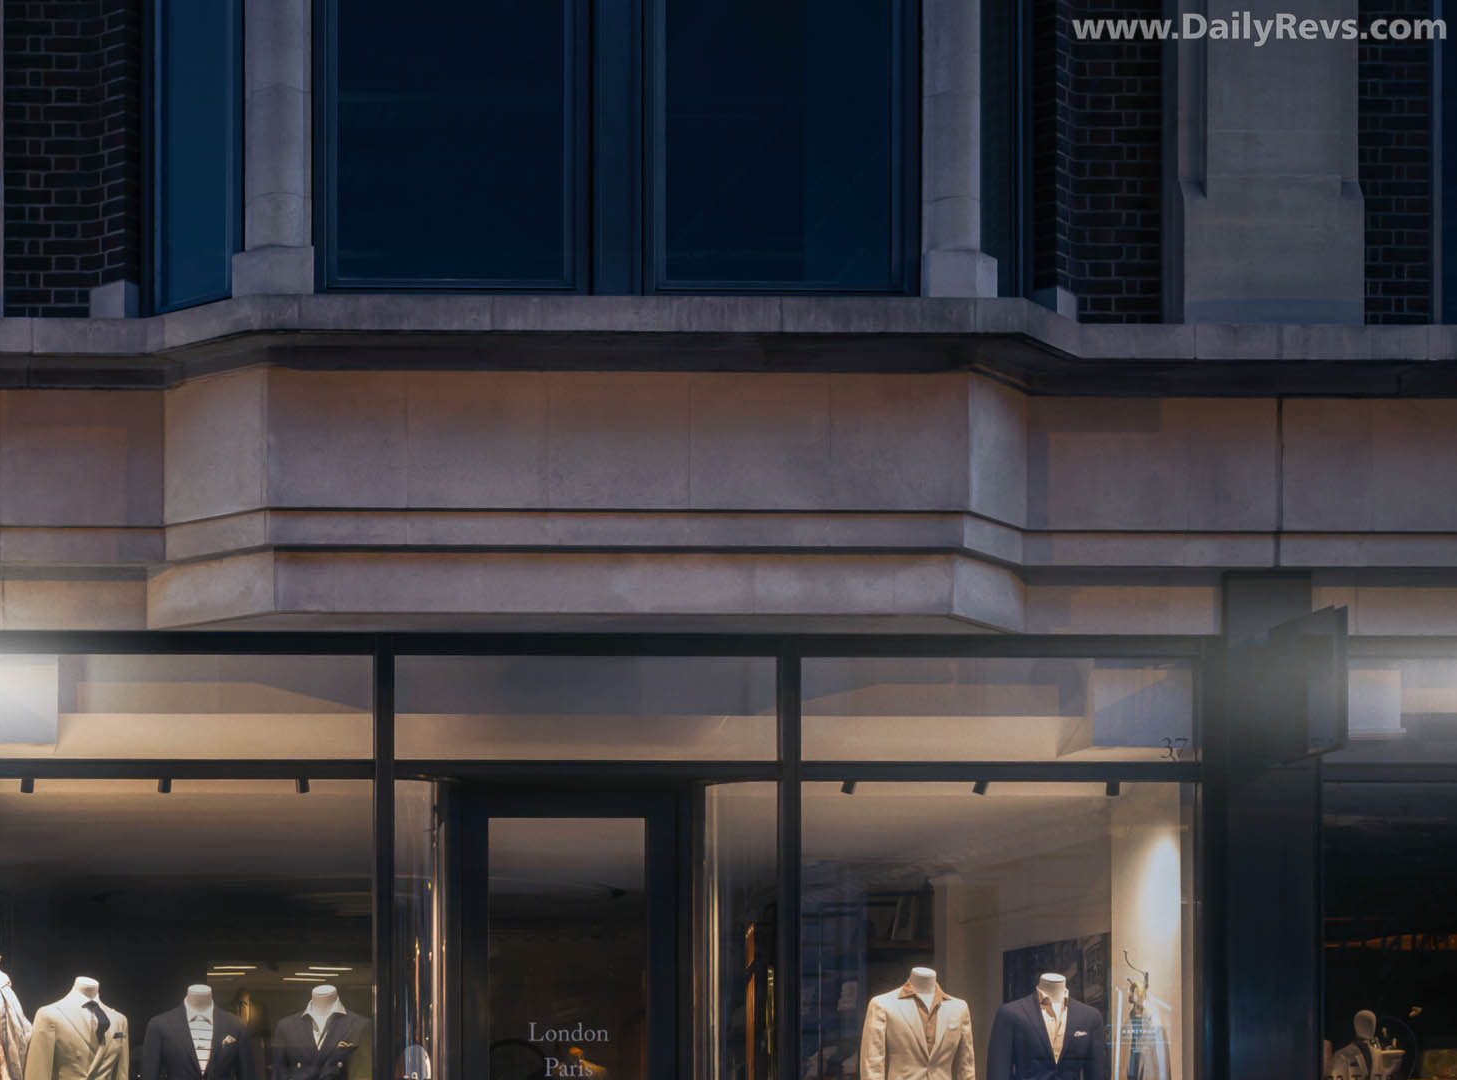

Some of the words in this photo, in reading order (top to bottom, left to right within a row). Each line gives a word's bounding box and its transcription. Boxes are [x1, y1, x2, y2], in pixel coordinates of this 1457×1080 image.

[1160, 736, 1189, 764] 37
[528, 1021, 610, 1043] London
[543, 1056, 594, 1078] Paris
